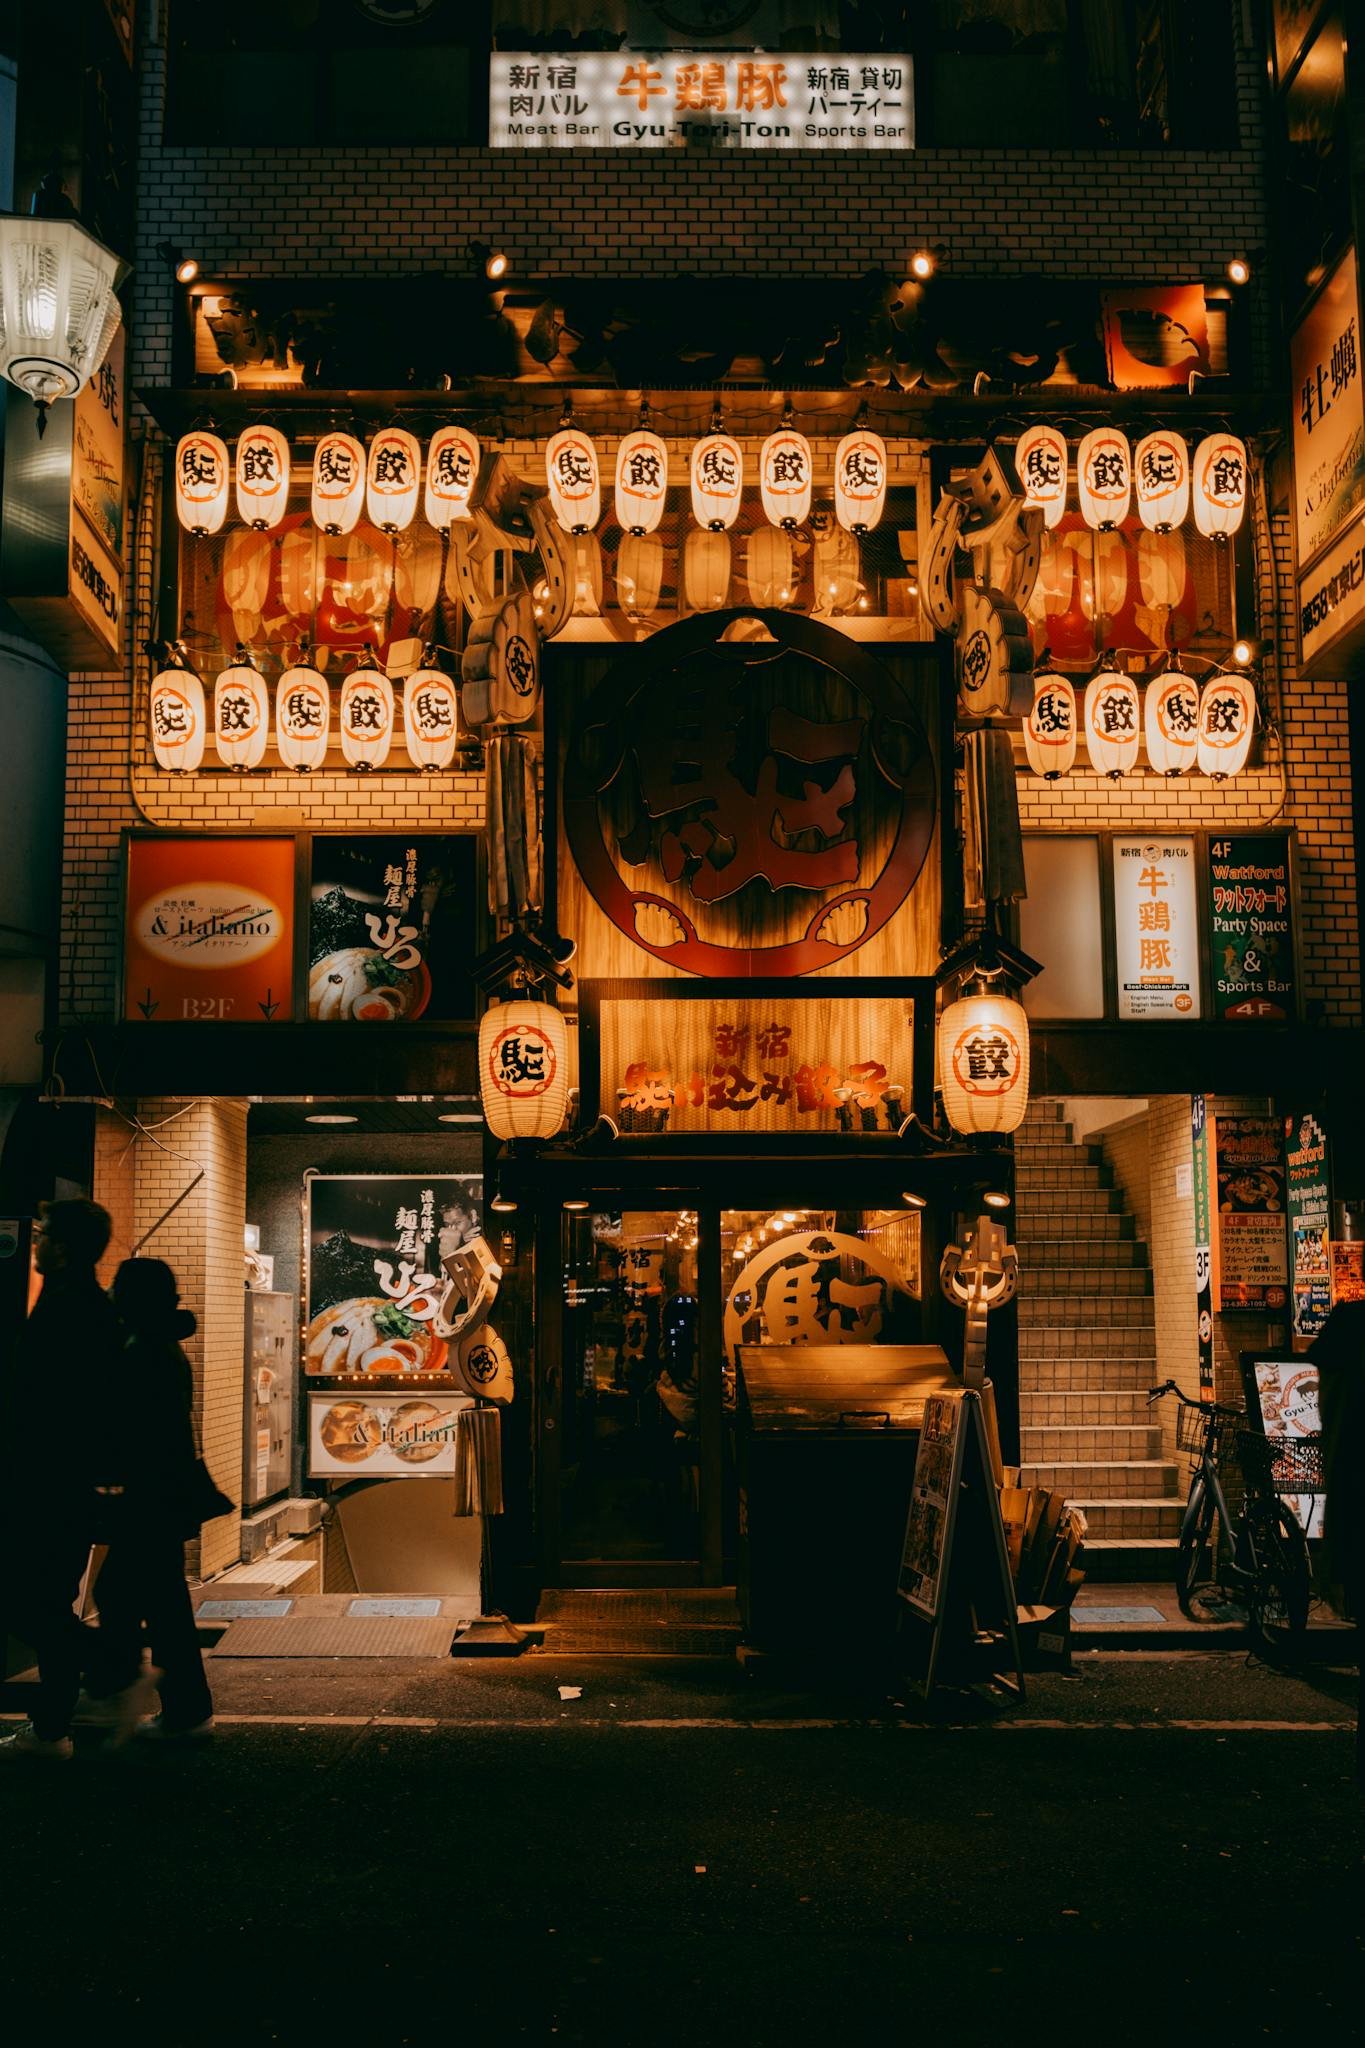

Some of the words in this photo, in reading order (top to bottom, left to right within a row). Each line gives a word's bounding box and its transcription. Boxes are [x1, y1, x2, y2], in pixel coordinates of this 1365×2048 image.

[509, 65, 577, 89] 新宿
[616, 62, 789, 113] 牛鶏豚
[808, 66, 850, 90] 新宿
[860, 67, 902, 90] 貸切
[509, 94, 588, 117] 肉バル
[808, 92, 902, 117] パーティー
[508, 123, 557, 136] Meat
[566, 123, 599, 136] Bar
[613, 121, 790, 137] Gyu-Tori-Ton
[805, 124, 867, 138] Sports
[875, 124, 906, 137] Bar
[1121, 848, 1141, 858] 新宿
[1163, 848, 1188, 858] 肉バル
[1212, 842, 1232, 858] 4F
[1212, 865, 1285, 880] Watford
[1213, 885, 1287, 913] ワットフォード
[152, 915, 168, 935] &
[180, 915, 270, 935] italiano
[1137, 866, 1171, 970] 牛鶏豚
[1213, 917, 1248, 935] Party
[1250, 917, 1288, 936] Space
[365, 912, 422, 970] ひろ
[1243, 950, 1261, 972] &
[1217, 980, 1264, 994] Sports
[1268, 980, 1292, 992] Bar
[182, 998, 235, 1018] B2F
[1236, 1003, 1272, 1015] 4F
[715, 1023, 792, 1061] 新宿
[1192, 1100, 1204, 1130] 4F
[1197, 1252, 1209, 1277] 3F
[374, 1259, 440, 1321] ひろ
[352, 1424, 369, 1443] &
[381, 1422, 455, 1444] italian
